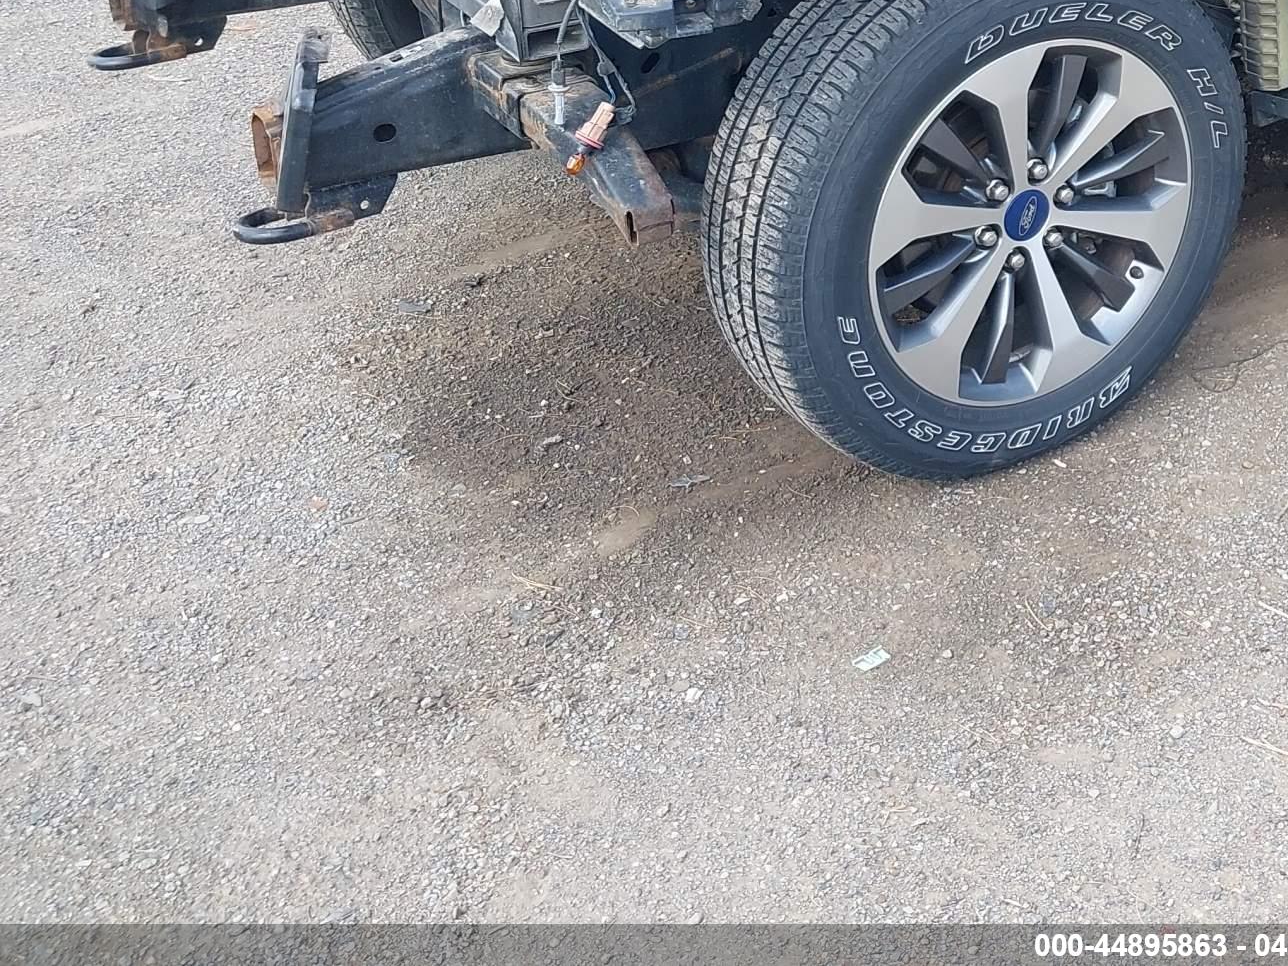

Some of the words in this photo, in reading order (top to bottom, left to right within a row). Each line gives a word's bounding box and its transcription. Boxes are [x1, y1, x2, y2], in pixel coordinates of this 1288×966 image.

[963, 1, 1184, 66] DUELER
[1186, 67, 1229, 150] H/L
[836, 315, 1133, 454] BRIDGESTONE
